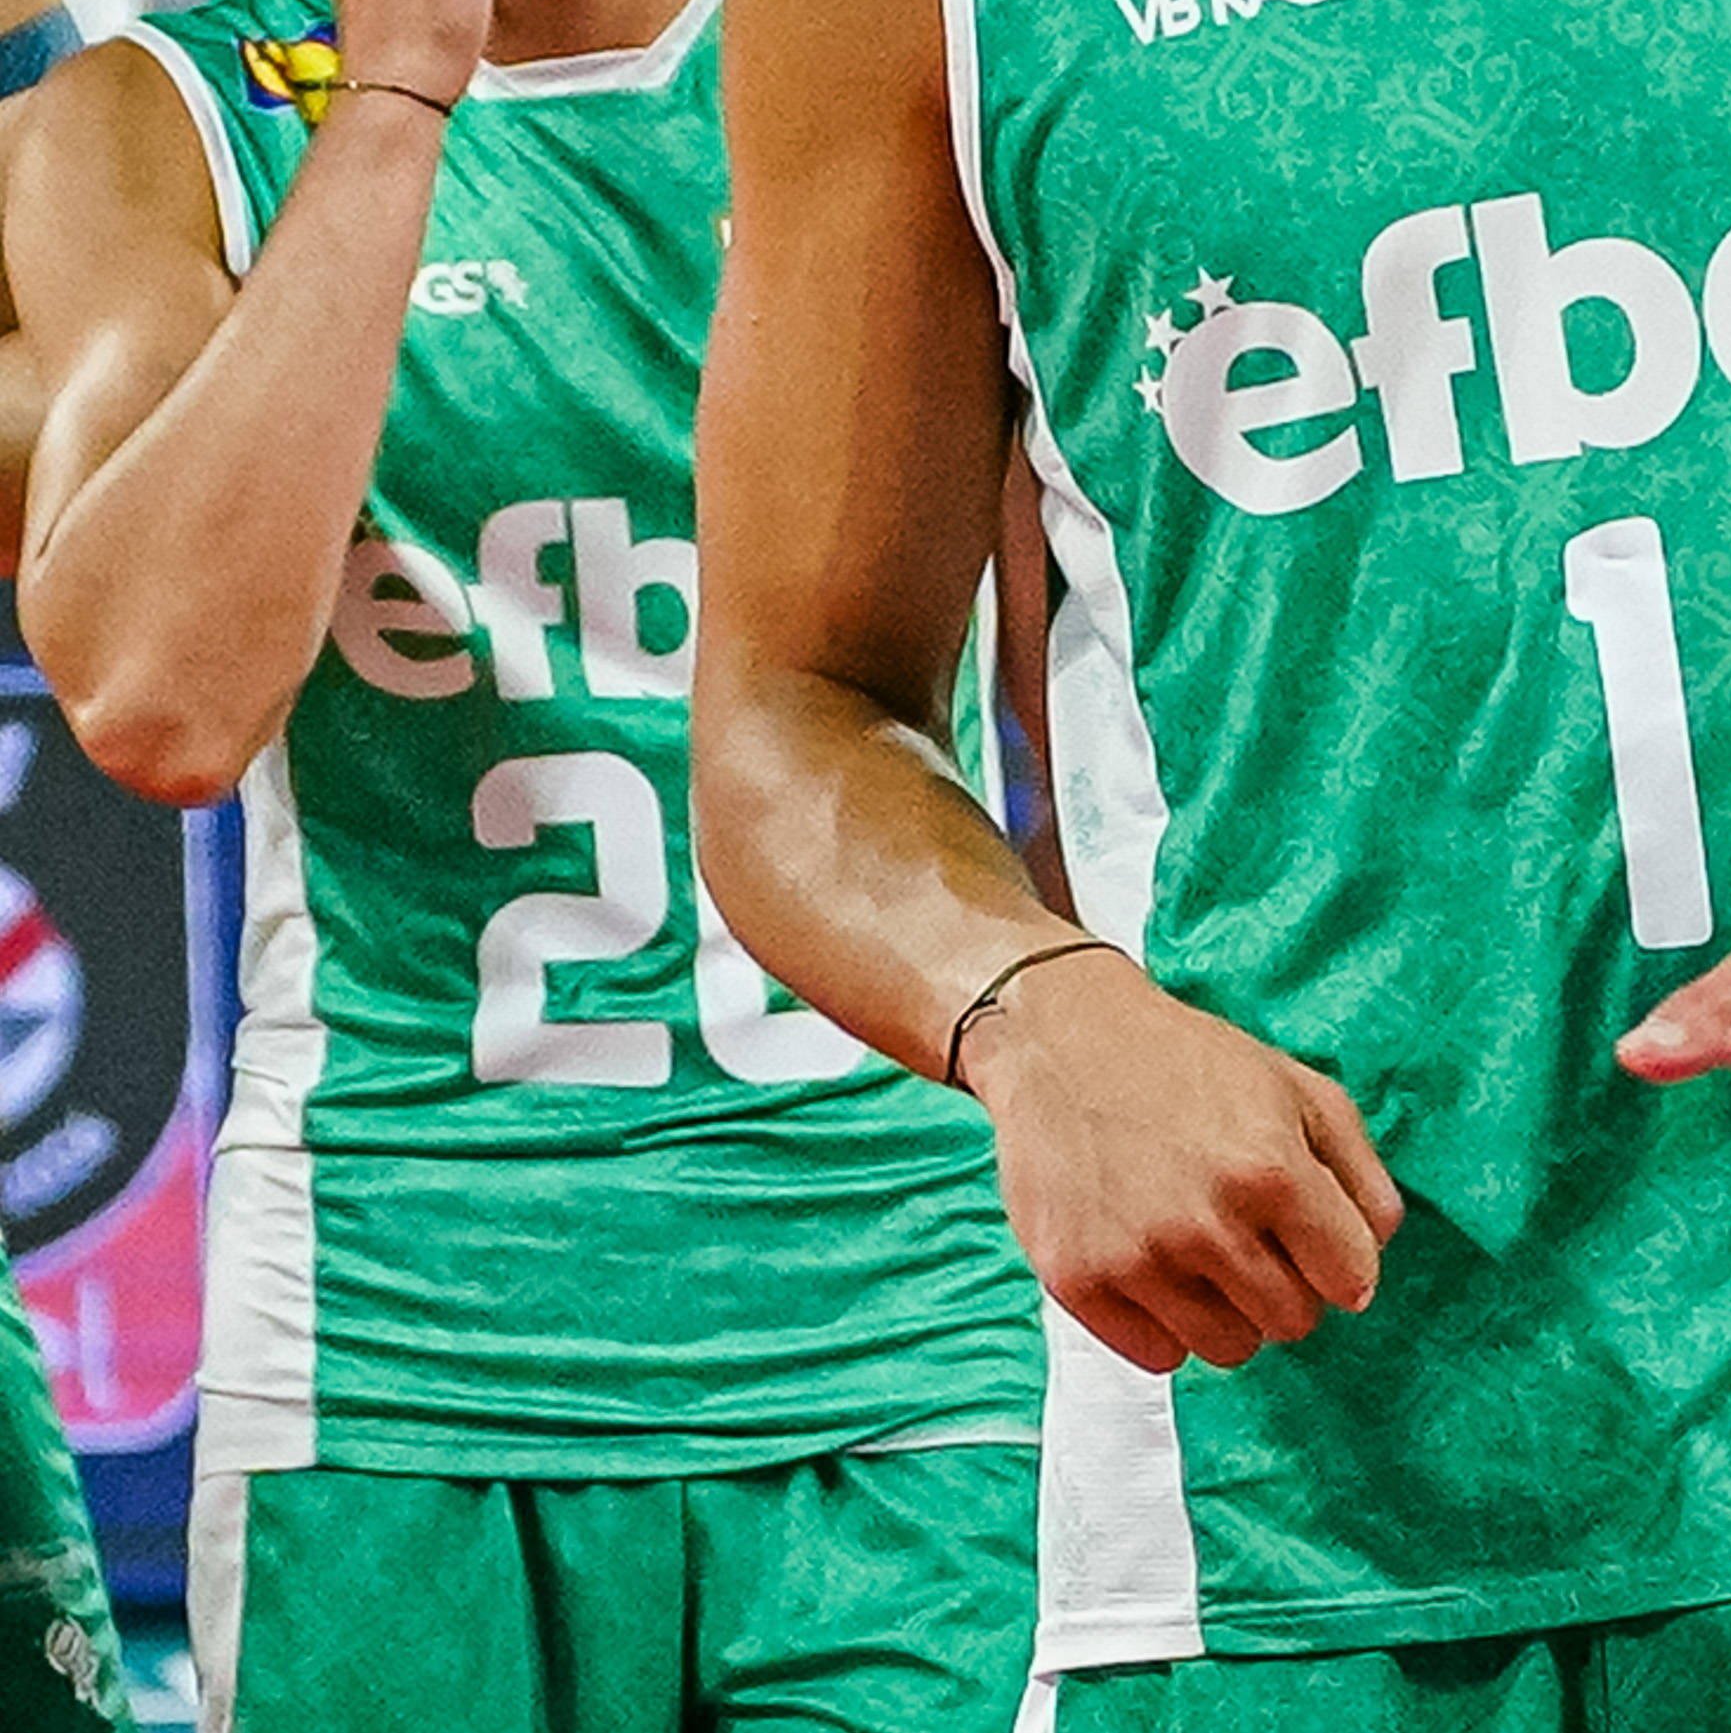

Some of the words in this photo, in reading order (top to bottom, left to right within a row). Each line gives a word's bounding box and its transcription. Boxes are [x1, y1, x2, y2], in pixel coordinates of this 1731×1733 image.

[410, 259, 487, 315] GS
[330, 497, 699, 702] efb
[1563, 515, 1713, 951] 1
